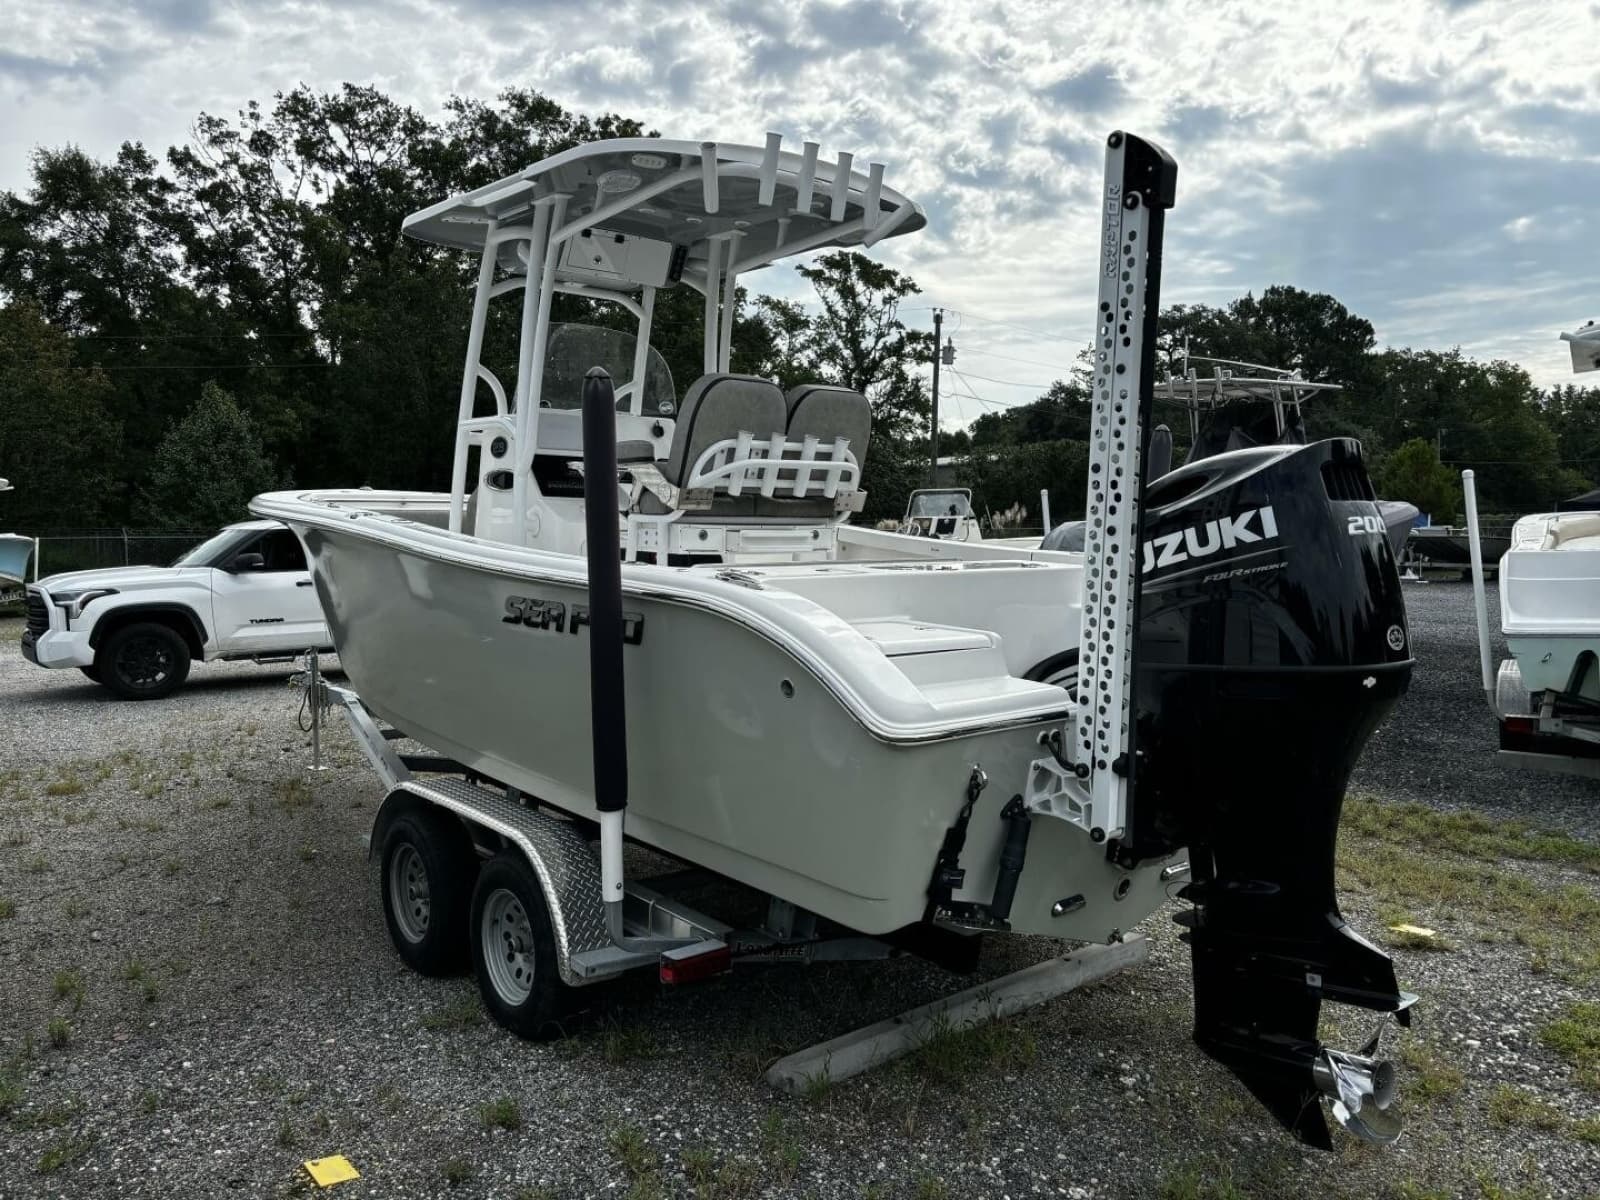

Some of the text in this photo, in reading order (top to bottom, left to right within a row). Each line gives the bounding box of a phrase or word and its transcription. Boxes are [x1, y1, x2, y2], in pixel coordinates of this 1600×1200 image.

[1347, 515, 1387, 535] 200
[502, 595, 645, 646] SEA PO
